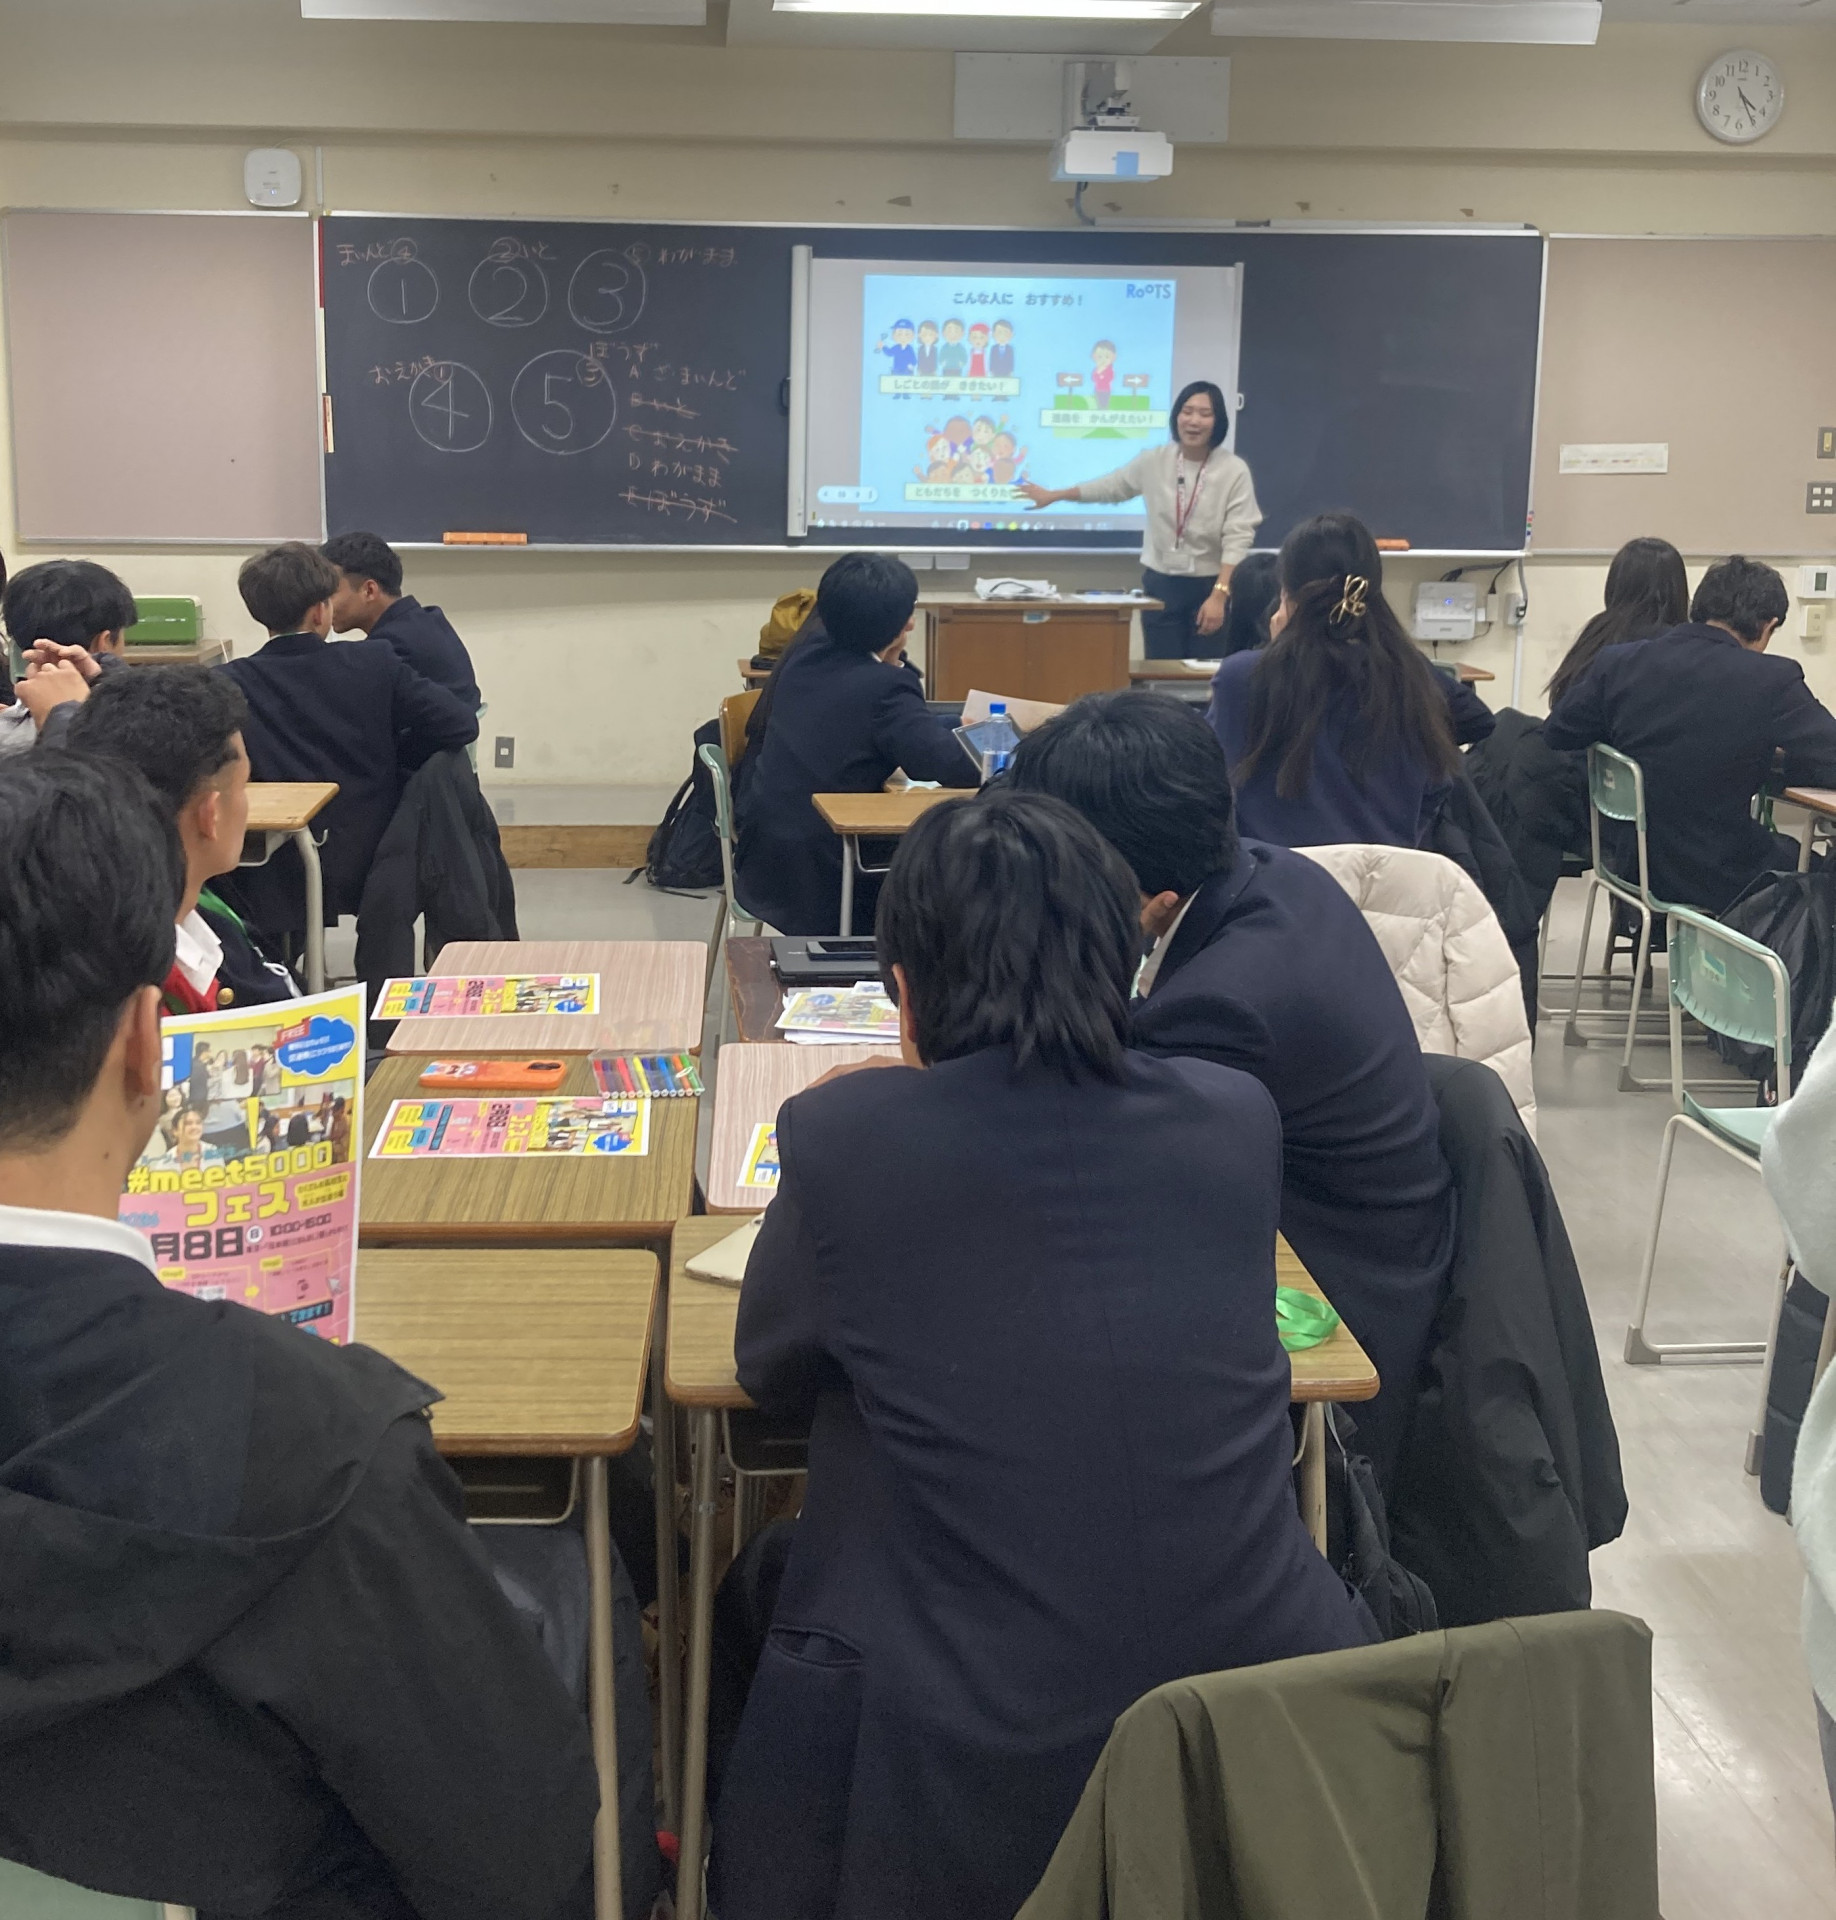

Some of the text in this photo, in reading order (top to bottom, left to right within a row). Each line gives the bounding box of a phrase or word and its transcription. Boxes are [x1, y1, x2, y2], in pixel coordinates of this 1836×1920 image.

[1739, 59, 1749, 73] 12
[1715, 75, 1725, 87] 10
[1763, 75, 1770, 87] 2
[1709, 90, 1717, 101] 9
[1767, 90, 1774, 103] 3
[1713, 104, 1720, 116] 8
[1759, 106, 1766, 118] 4
[1723, 115, 1731, 127] 7
[1735, 120, 1743, 130] 6
[953, 292, 1014, 306] こんな人に
[281, 1024, 305, 1042] FREE
[127, 1140, 333, 1193] #meet5000
[183, 1181, 291, 1227] フェス
